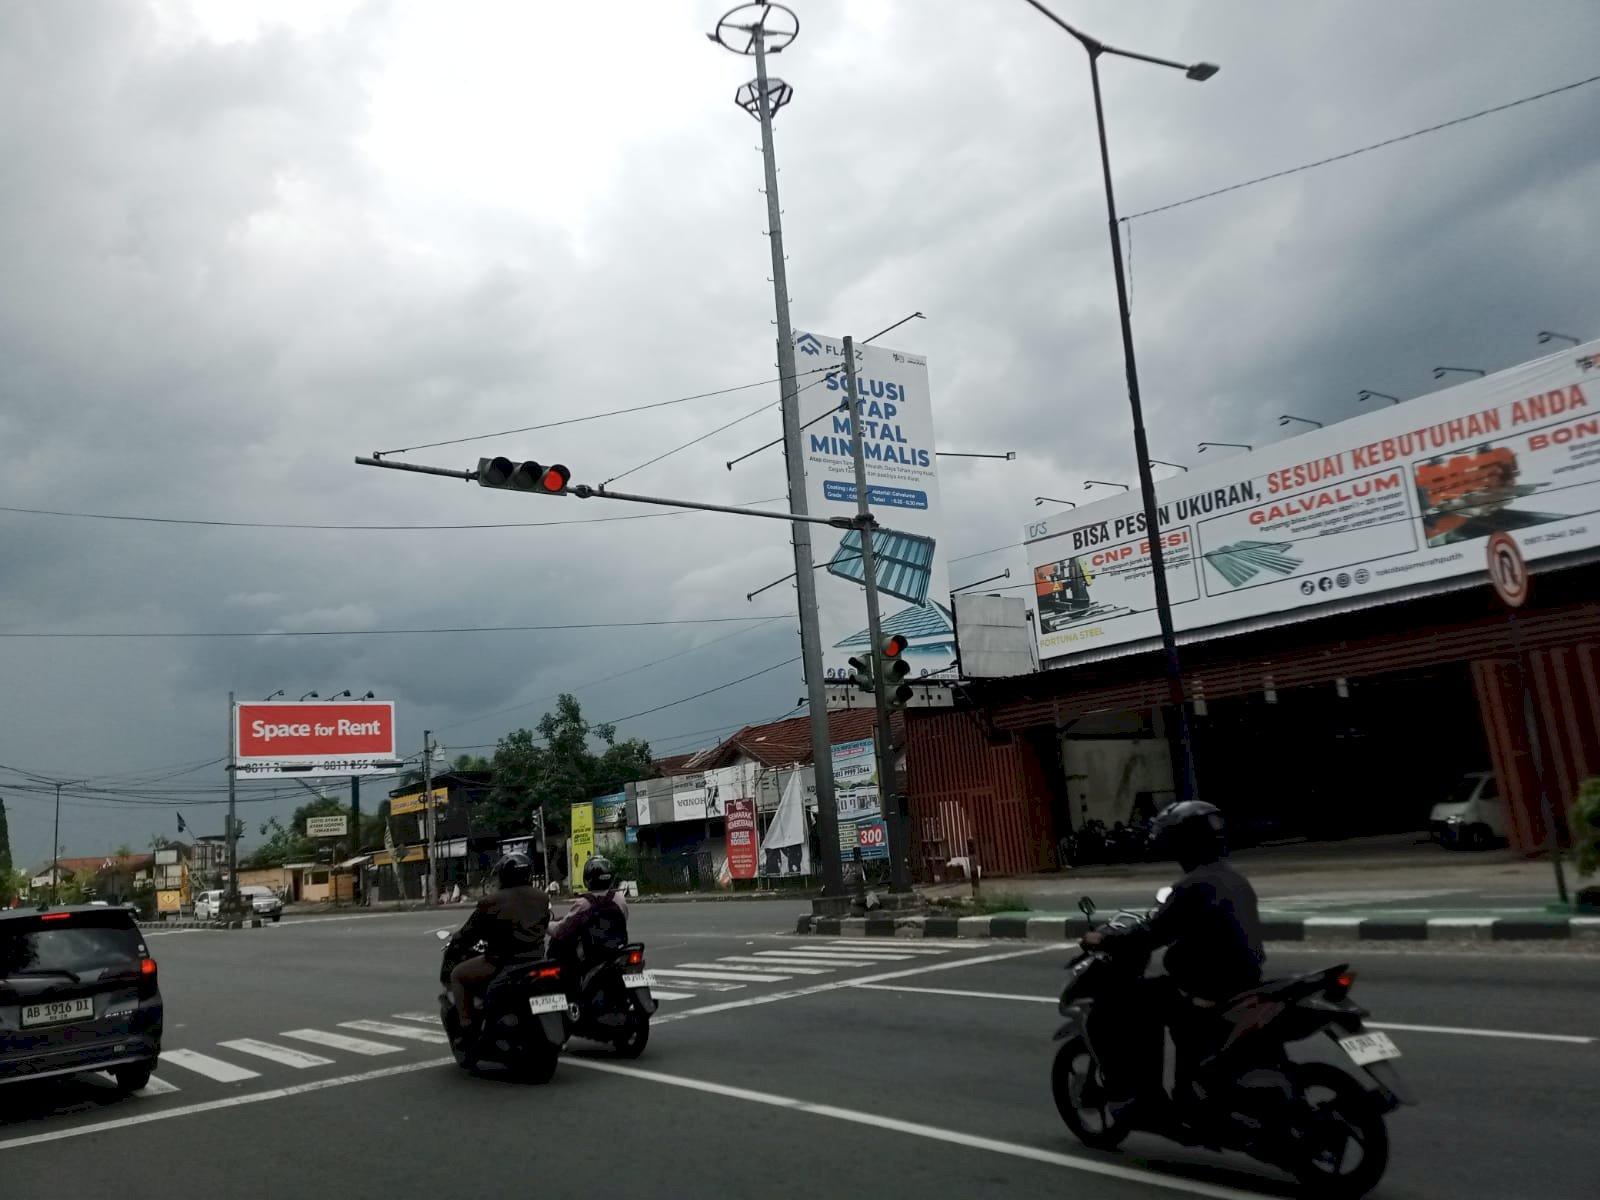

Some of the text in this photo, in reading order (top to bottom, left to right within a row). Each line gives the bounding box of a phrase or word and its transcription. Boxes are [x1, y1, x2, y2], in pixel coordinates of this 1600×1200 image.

[826, 345, 864, 361] FLAZ
[811, 434, 930, 467] MINMALIS
[1073, 384, 1587, 550] BISA PESN UKURAN, SESUAI KEBUTUHAN ANDA
[1248, 473, 1401, 525] GALVALUM
[1091, 531, 1189, 567] CNP BESI
[1040, 627, 1105, 648] FORTUNA STEEL
[252, 719, 381, 742] Space for Rent
[860, 828, 882, 844] 300
[27, 1006, 41, 1018] AB
[76, 999, 89, 1012] DI
